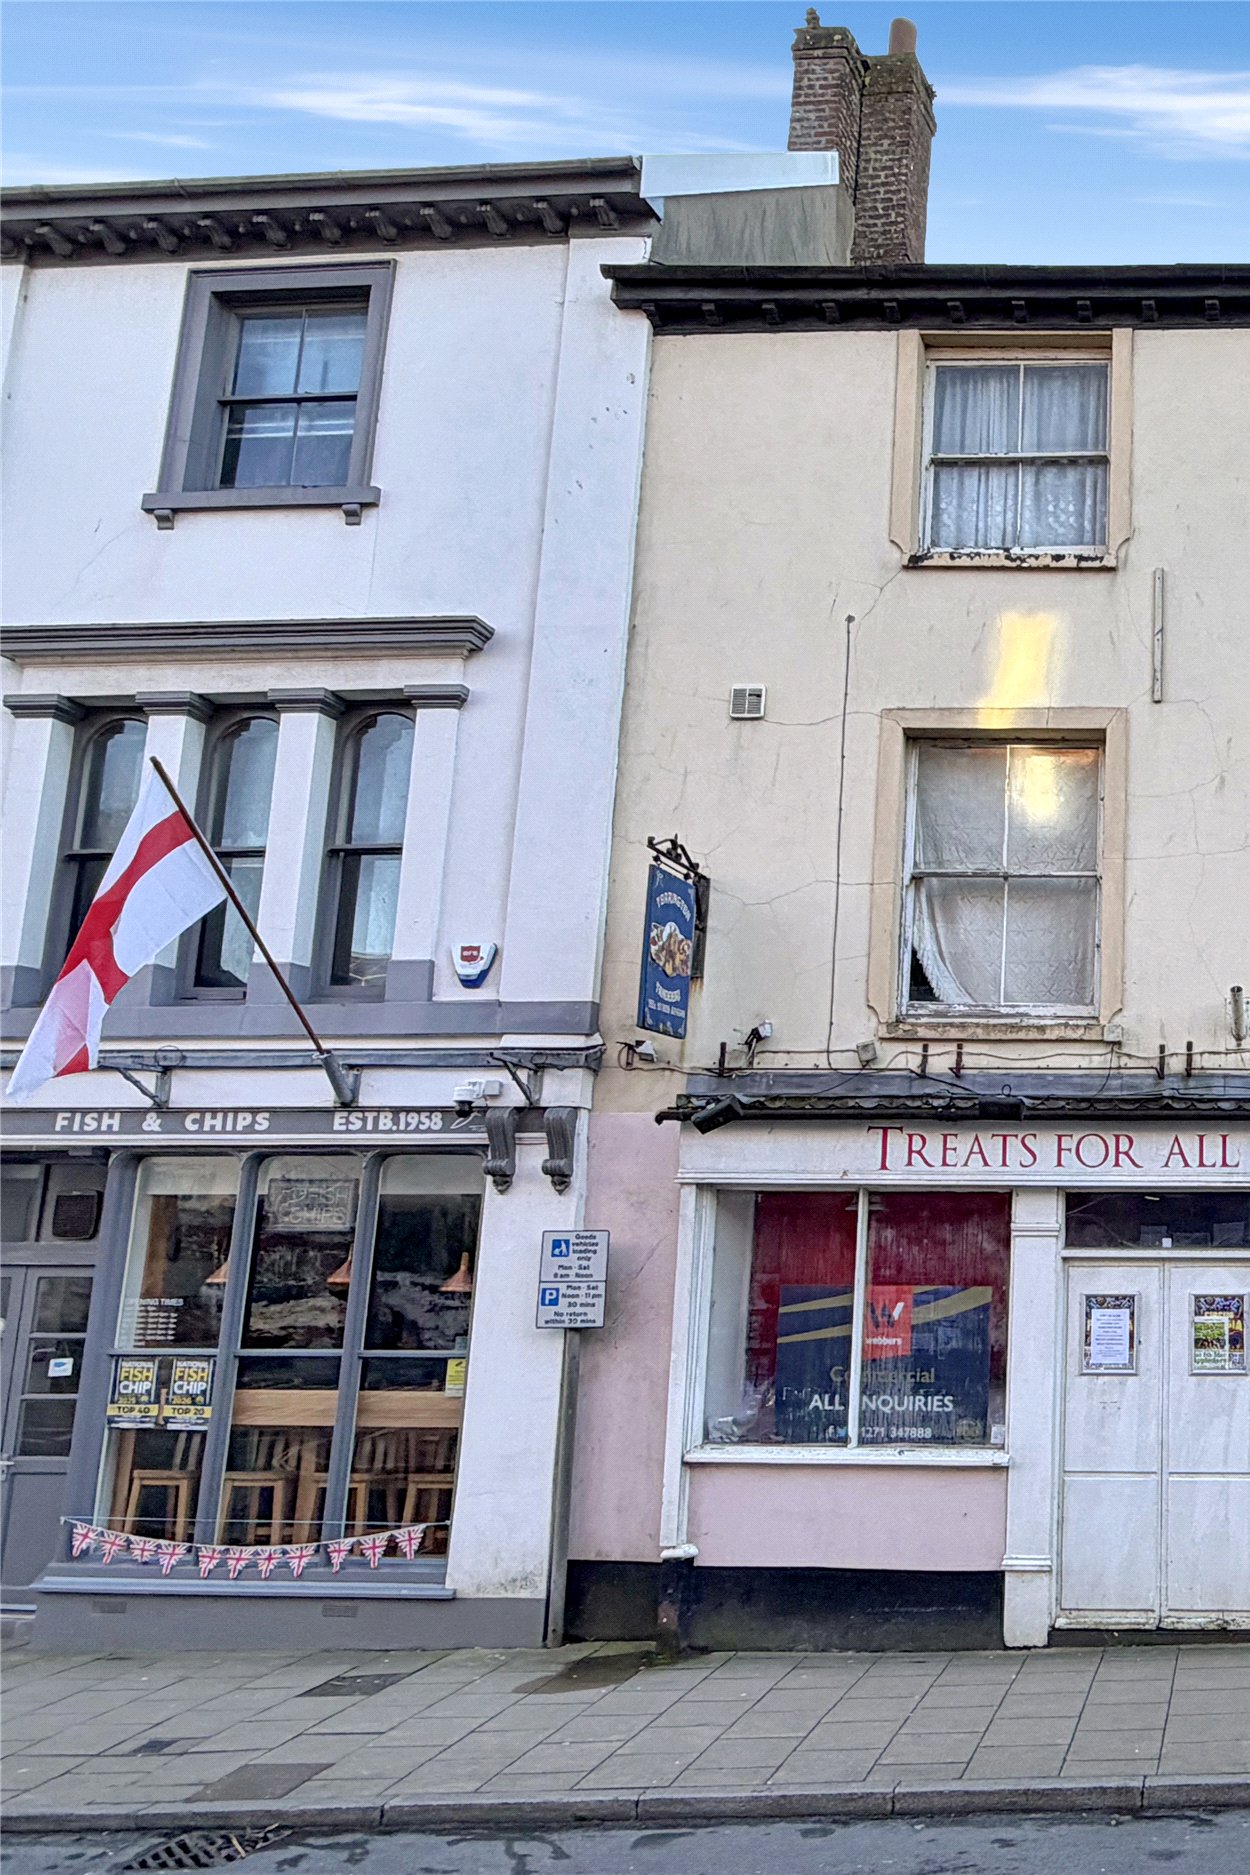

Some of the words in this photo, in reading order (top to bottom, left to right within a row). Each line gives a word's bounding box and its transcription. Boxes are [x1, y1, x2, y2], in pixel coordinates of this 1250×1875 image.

[54, 1112, 120, 1132] FISH
[142, 1112, 162, 1132] &
[184, 1112, 270, 1132] CHIPS
[333, 1112, 442, 1130] ESTB.1958
[867, 1125, 1037, 1170] TREATS
[1054, 1133, 1144, 1168] FOR
[1161, 1133, 1240, 1168] ALL
[120, 1368, 153, 1381] FISH
[175, 1368, 208, 1381] FISH
[120, 1381, 151, 1394] CHIP
[174, 1381, 207, 1394] CHIP
[137, 1406, 150, 1414] 40
[809, 1394, 844, 1411] ALL
[862, 1395, 954, 1413] NQUIRIES
[860, 1426, 884, 1438] 1271
[890, 1427, 932, 1438] 347888
